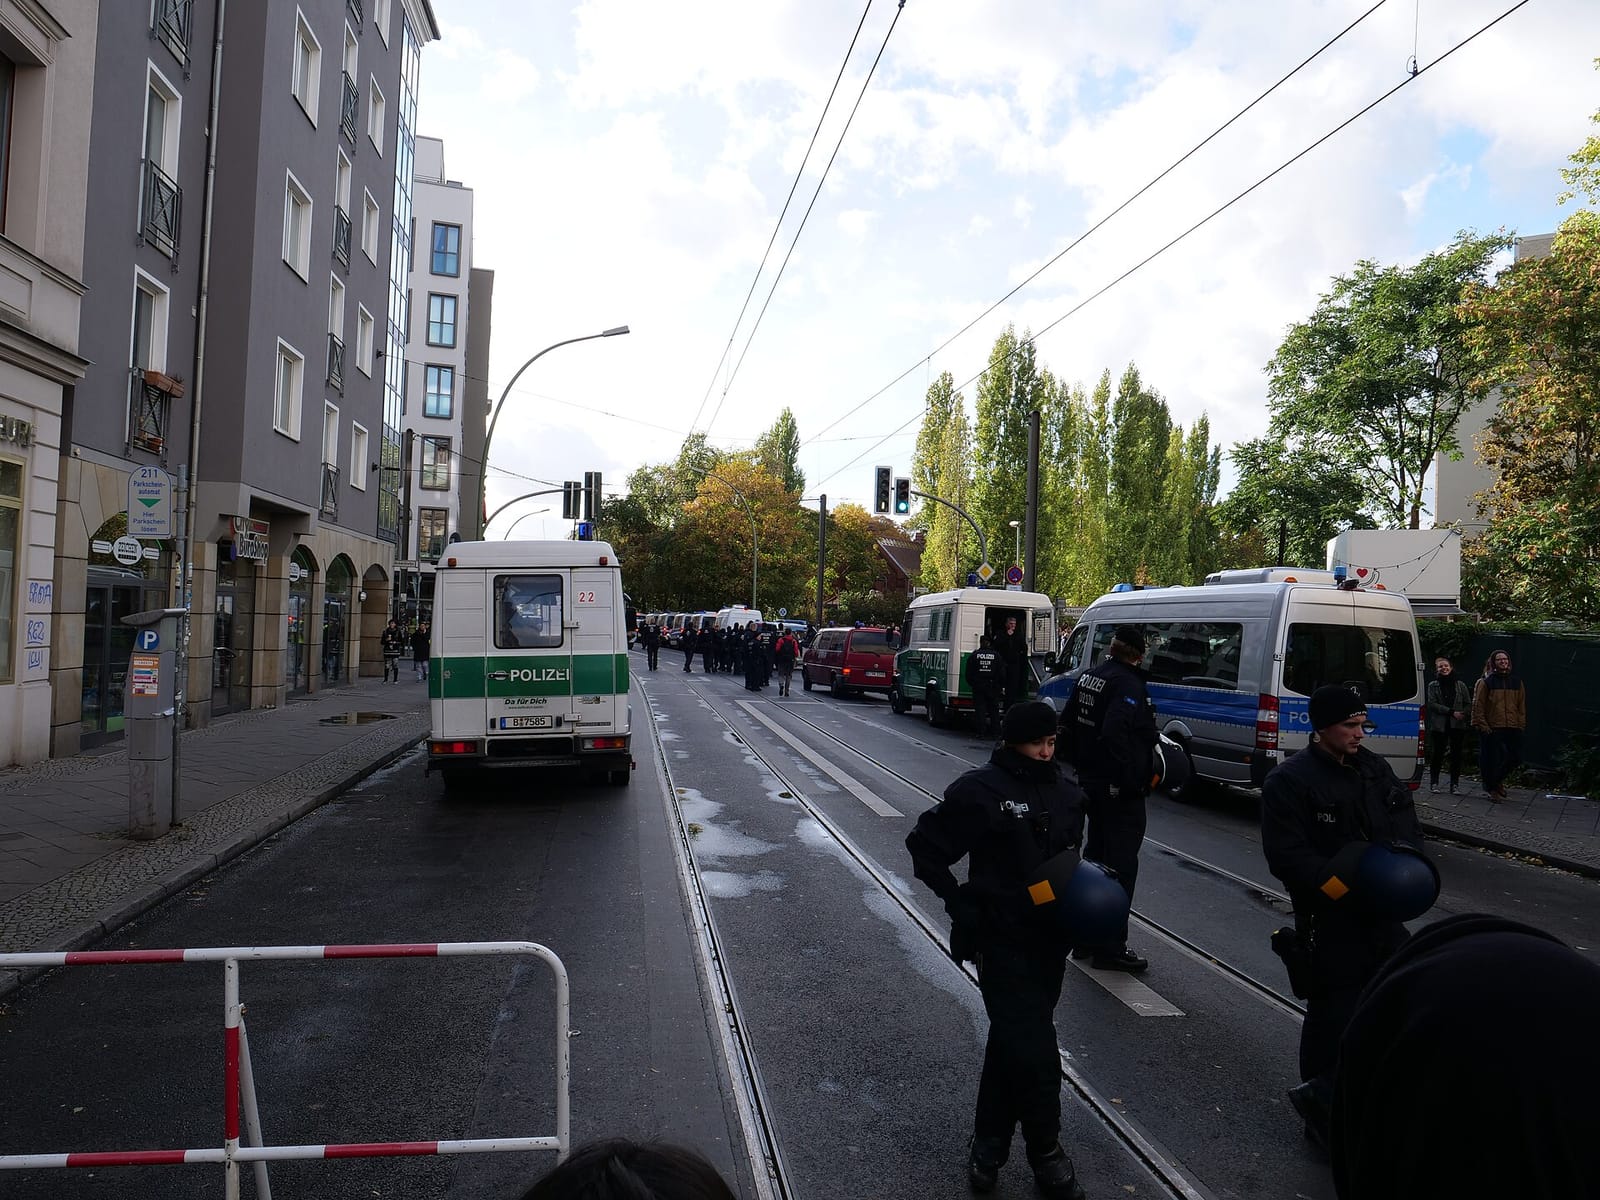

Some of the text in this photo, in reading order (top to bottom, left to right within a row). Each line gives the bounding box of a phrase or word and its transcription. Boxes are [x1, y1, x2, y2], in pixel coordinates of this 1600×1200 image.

[141, 469, 158, 478] 211
[133, 480, 165, 488] Parkschein-
[579, 591, 594, 603] 22
[144, 631, 157, 649] P
[921, 653, 948, 671] POLIZEI
[510, 669, 570, 681] POLIZEI
[1077, 673, 1106, 693] POLIZEI
[525, 717, 546, 726] 7585
